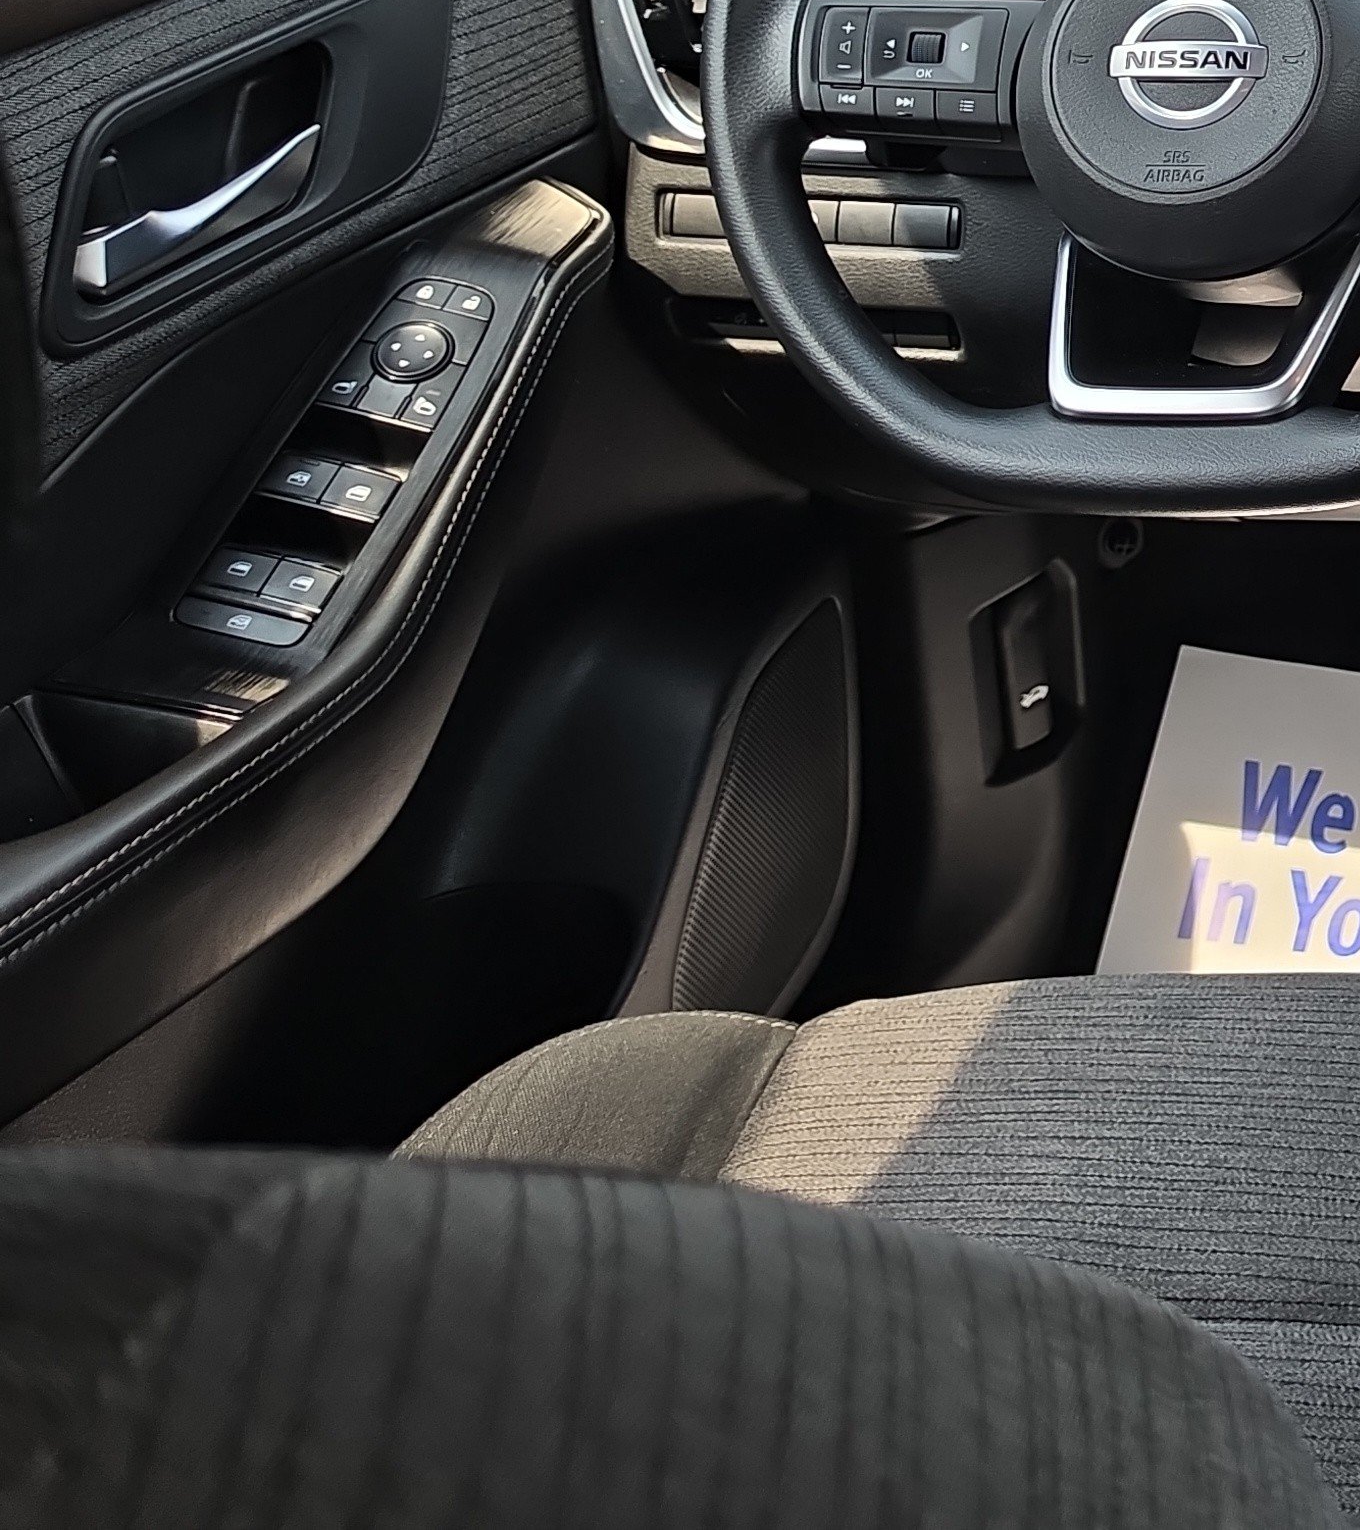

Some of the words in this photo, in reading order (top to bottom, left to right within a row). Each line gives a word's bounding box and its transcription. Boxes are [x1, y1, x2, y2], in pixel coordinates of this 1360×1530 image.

[1125, 50, 1249, 70] NISSAN
[915, 68, 933, 79] OK
[1162, 150, 1191, 164] SRS
[1143, 169, 1205, 183] AIRBAG
[1239, 758, 1357, 855] We
[1176, 854, 1257, 947] In
